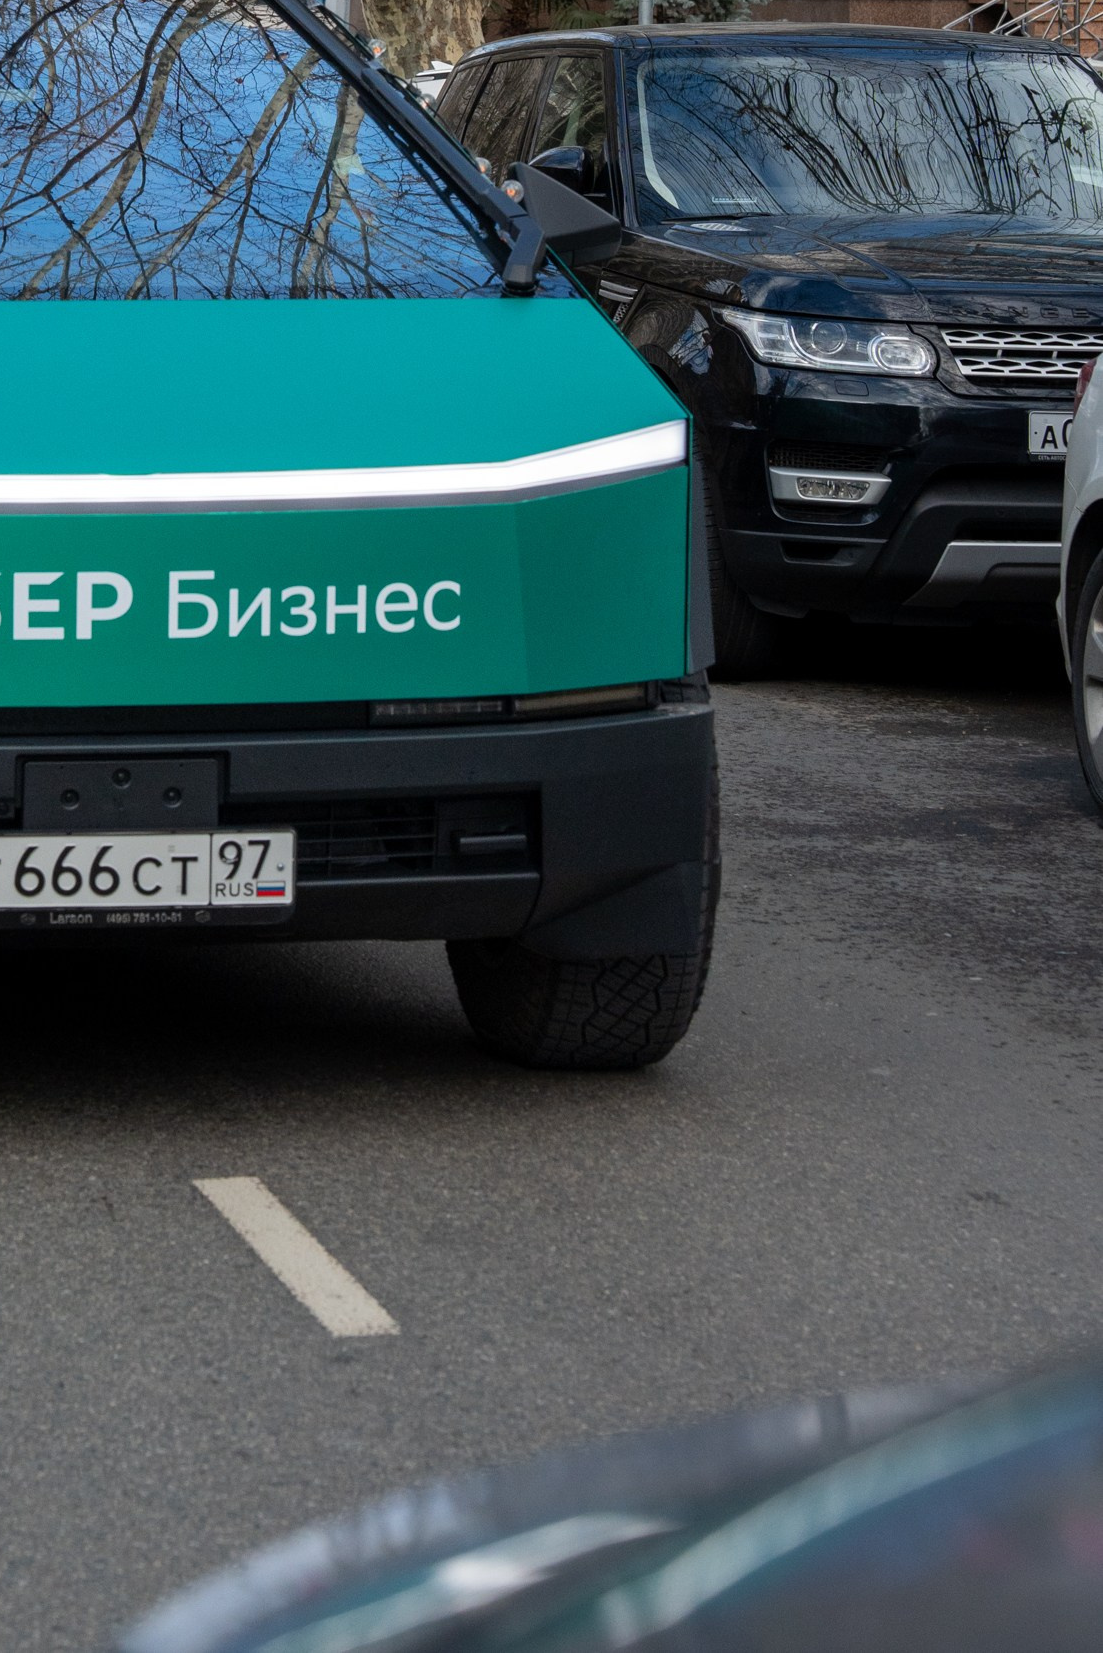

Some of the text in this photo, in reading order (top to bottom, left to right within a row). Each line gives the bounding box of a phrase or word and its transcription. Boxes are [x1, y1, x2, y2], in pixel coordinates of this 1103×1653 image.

[948, 305, 1090, 320] RANGE
[167, 570, 461, 639] Бизнес
[218, 839, 272, 880] 97
[215, 882, 254, 898] RUS
[50, 912, 93, 925] Larson
